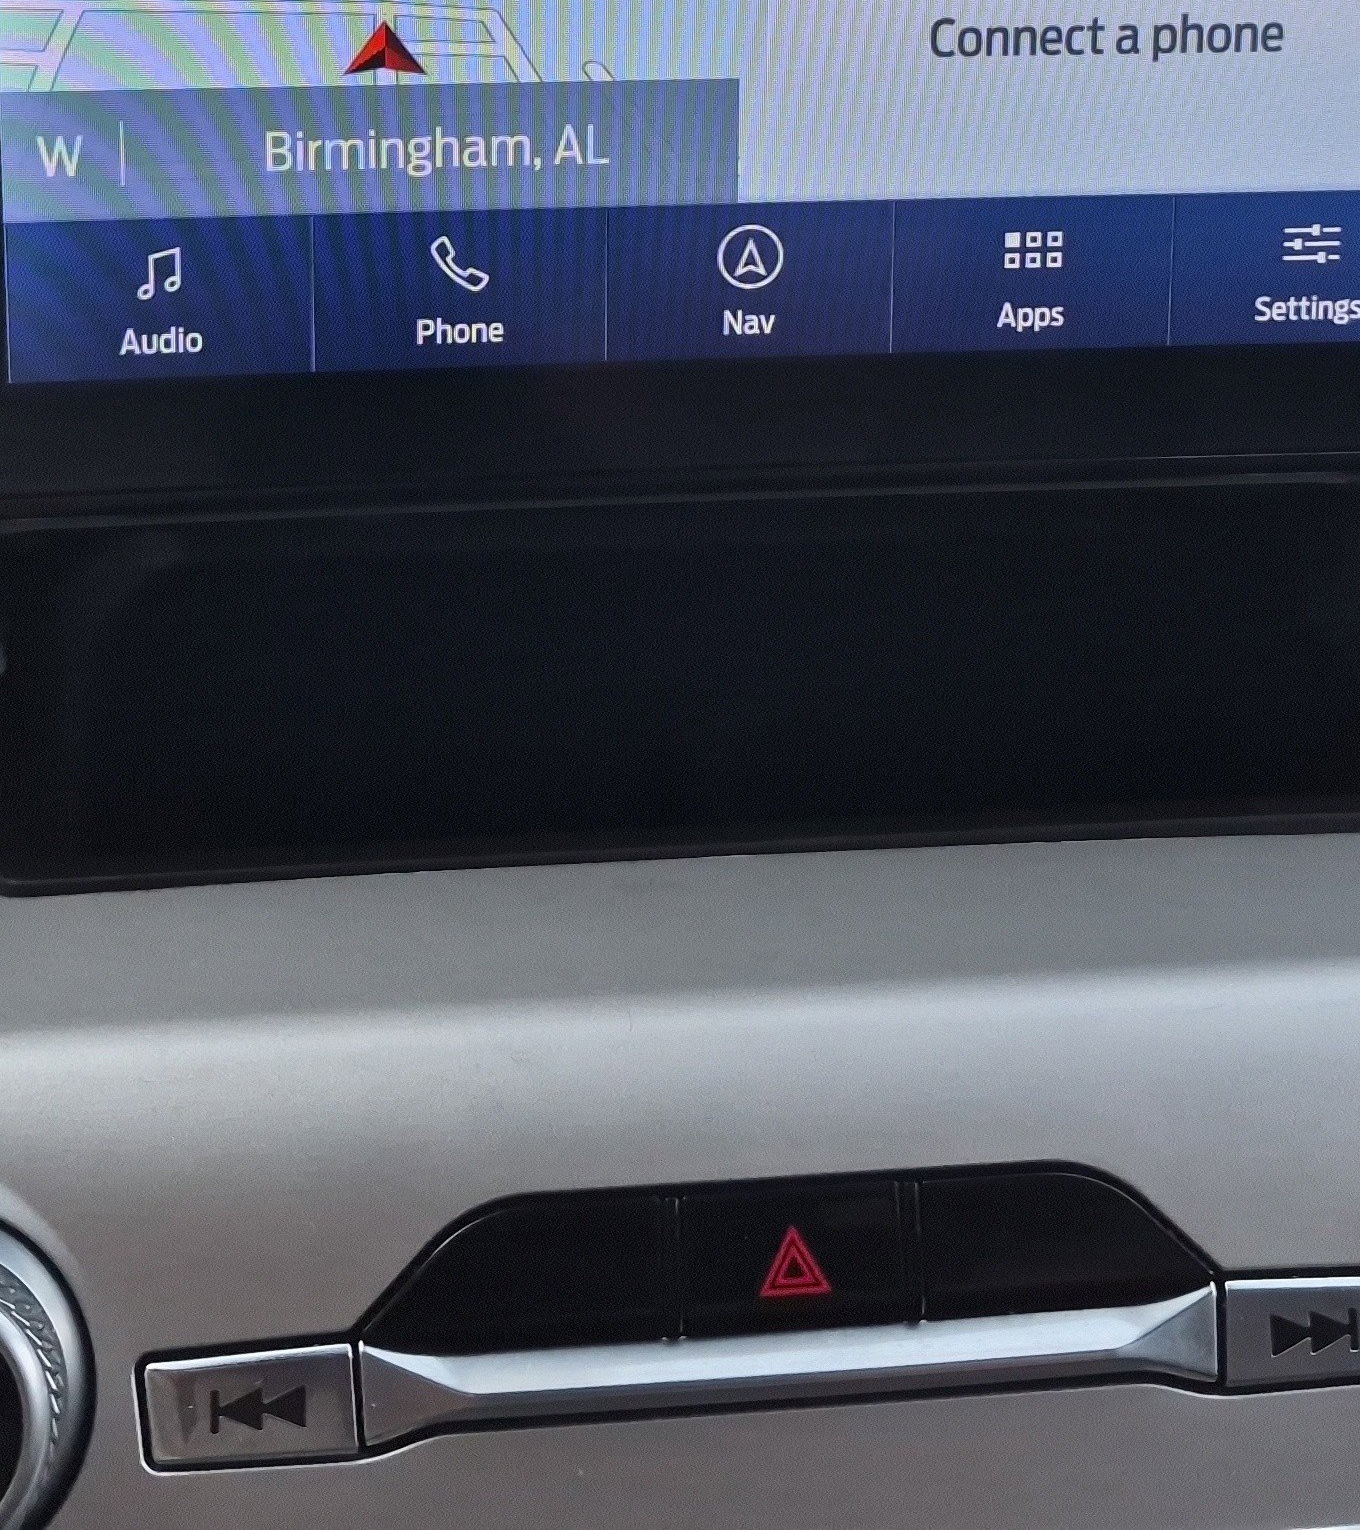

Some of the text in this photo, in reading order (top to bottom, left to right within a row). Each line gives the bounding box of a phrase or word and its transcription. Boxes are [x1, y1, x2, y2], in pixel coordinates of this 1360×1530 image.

[930, 13, 1285, 63] Connect a phone
[37, 134, 83, 177] W
[265, 124, 609, 176] Birmingham, AL
[416, 317, 505, 346] Phone
[723, 309, 776, 336] Nav
[996, 301, 1065, 333] Apps
[119, 325, 203, 356] Audio
